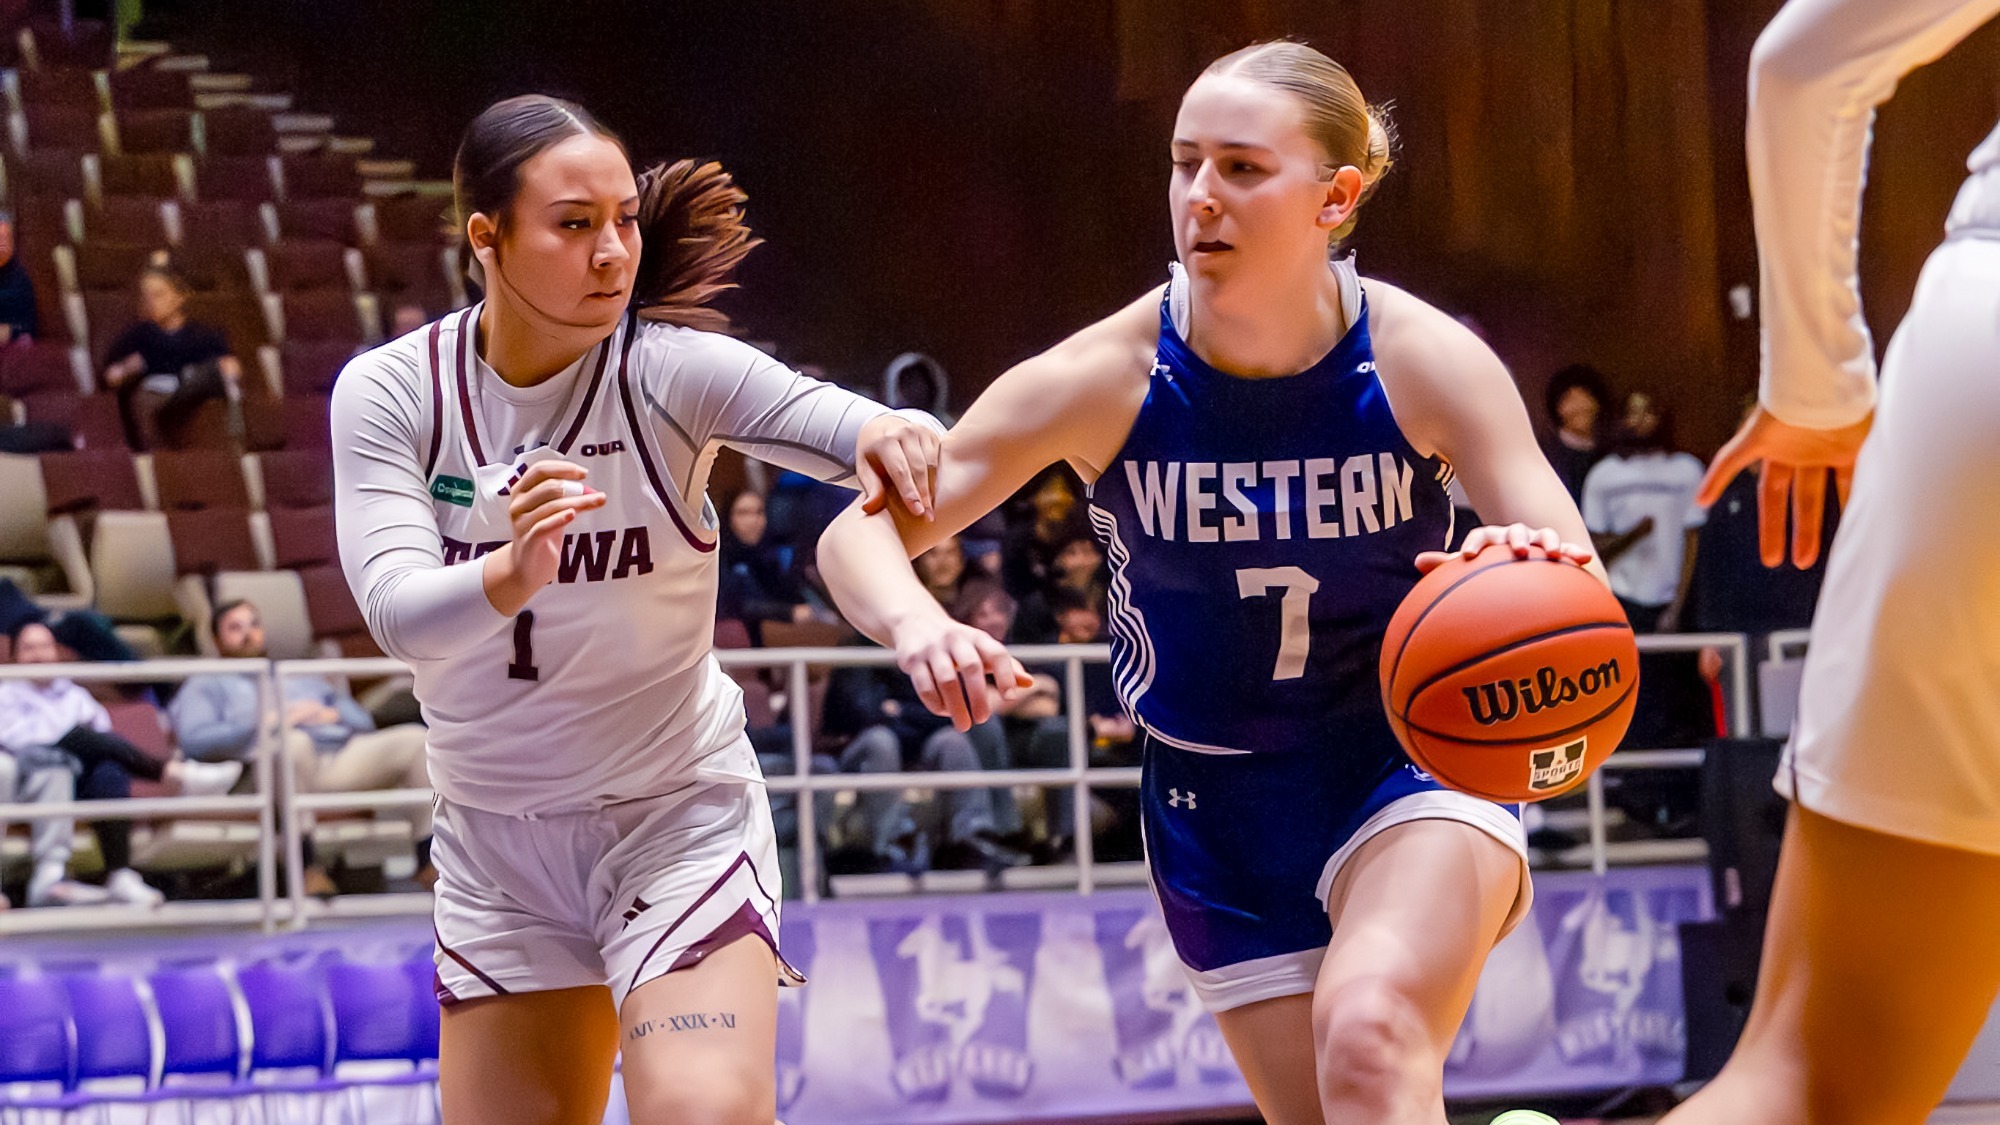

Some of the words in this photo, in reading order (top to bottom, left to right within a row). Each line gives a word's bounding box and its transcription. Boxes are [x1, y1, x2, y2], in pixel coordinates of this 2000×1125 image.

[580, 440, 626, 457] OUA
[1124, 452, 1414, 542] WESTERN
[508, 609, 539, 681] 1
[1235, 566, 1321, 681] 7
[1462, 658, 1621, 726] Wilson
